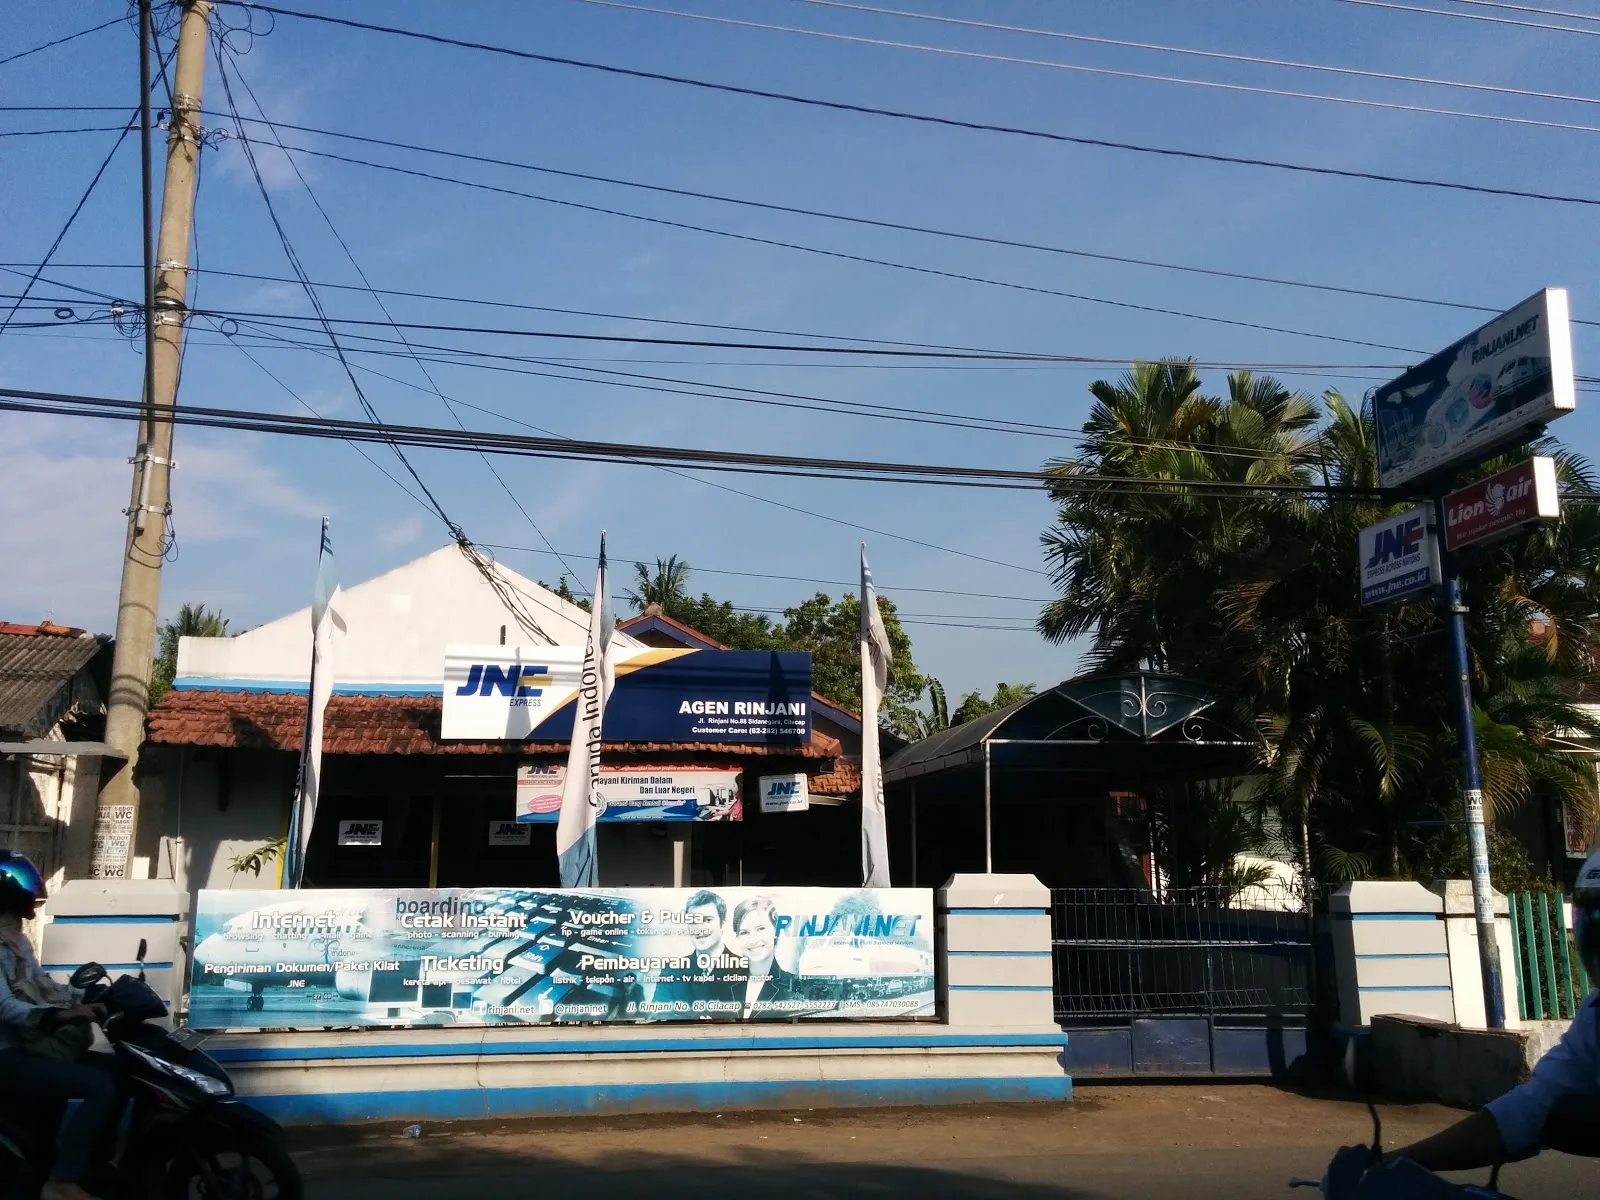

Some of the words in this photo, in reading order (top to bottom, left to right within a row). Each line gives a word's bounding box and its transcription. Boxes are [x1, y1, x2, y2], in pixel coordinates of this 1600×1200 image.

[1472, 314, 1539, 366] RINJANI.NET
[1448, 500, 1484, 527] Lion
[1506, 477, 1532, 502] air
[1364, 516, 1424, 570] JNE
[1367, 565, 1385, 579] EXPRESS
[1386, 559, 1402, 572] ACROSS
[1364, 570, 1427, 599] www.jne.co.id
[456, 664, 553, 697] JNE
[509, 699, 542, 707] EXPRESS
[679, 701, 729, 714] AGEN
[734, 702, 806, 716] RINJANI
[749, 727, 778, 735] (62-282)
[620, 777, 649, 785] Kiriman
[650, 776, 673, 785] Dalam
[640, 786, 654, 794] Dan
[655, 786, 670, 794] Luar
[671, 786, 695, 795] Negeri
[767, 782, 800, 795] JNE
[115, 811, 132, 819] WC
[344, 823, 379, 835] JNE
[104, 869, 124, 877] WC
[1476, 864, 1488, 873] W
[396, 897, 487, 915] boarding
[251, 910, 336, 930] Internet
[401, 912, 454, 928] Cetak
[461, 912, 527, 928] Instant
[569, 910, 635, 925] Voucher
[641, 910, 654, 924] &
[660, 910, 704, 924] Pulsa
[775, 914, 922, 937] RINJANI.NET
[224, 932, 263, 943] browsing
[272, 931, 307, 941] chatting
[407, 930, 433, 939] photo
[441, 930, 479, 940] scanning
[488, 930, 520, 939] burning
[561, 928, 572, 937] hp
[580, 928, 602, 937] game
[604, 927, 628, 936] online
[636, 927, 659, 936] token
[587, 935, 609, 944] Enter
[523, 951, 544, 962] Shift
[203, 963, 272, 976] Pengiriman
[275, 961, 369, 973] Dokumen/Paket
[372, 960, 400, 971] Kilat
[420, 955, 504, 974] Ticketing
[580, 954, 691, 973] Pembayaran
[696, 953, 749, 969] Online
[287, 979, 305, 988] JNE
[403, 977, 431, 986] kereta
[456, 977, 492, 987] pesawat
[500, 976, 521, 985] hotel
[553, 976, 577, 984] listrik
[585, 975, 615, 985] telepon
[623, 975, 635, 983] air
[643, 974, 674, 983] internet
[693, 974, 715, 982] kabel
[722, 974, 748, 982] cicilan
[749, 974, 774, 982] motor
[555, 1004, 607, 1015] @rinjaninet
[626, 1002, 637, 1012] Jl.
[639, 1002, 672, 1012] Rinjani
[674, 1002, 690, 1011] No.
[693, 1002, 705, 1011] 88
[707, 1002, 740, 1012] Cilacap
[753, 1001, 771, 1010] 0282
[845, 1000, 861, 1008] SMS
[866, 1000, 919, 1008] 085747030088
[487, 1005, 535, 1016] rinjani.net
